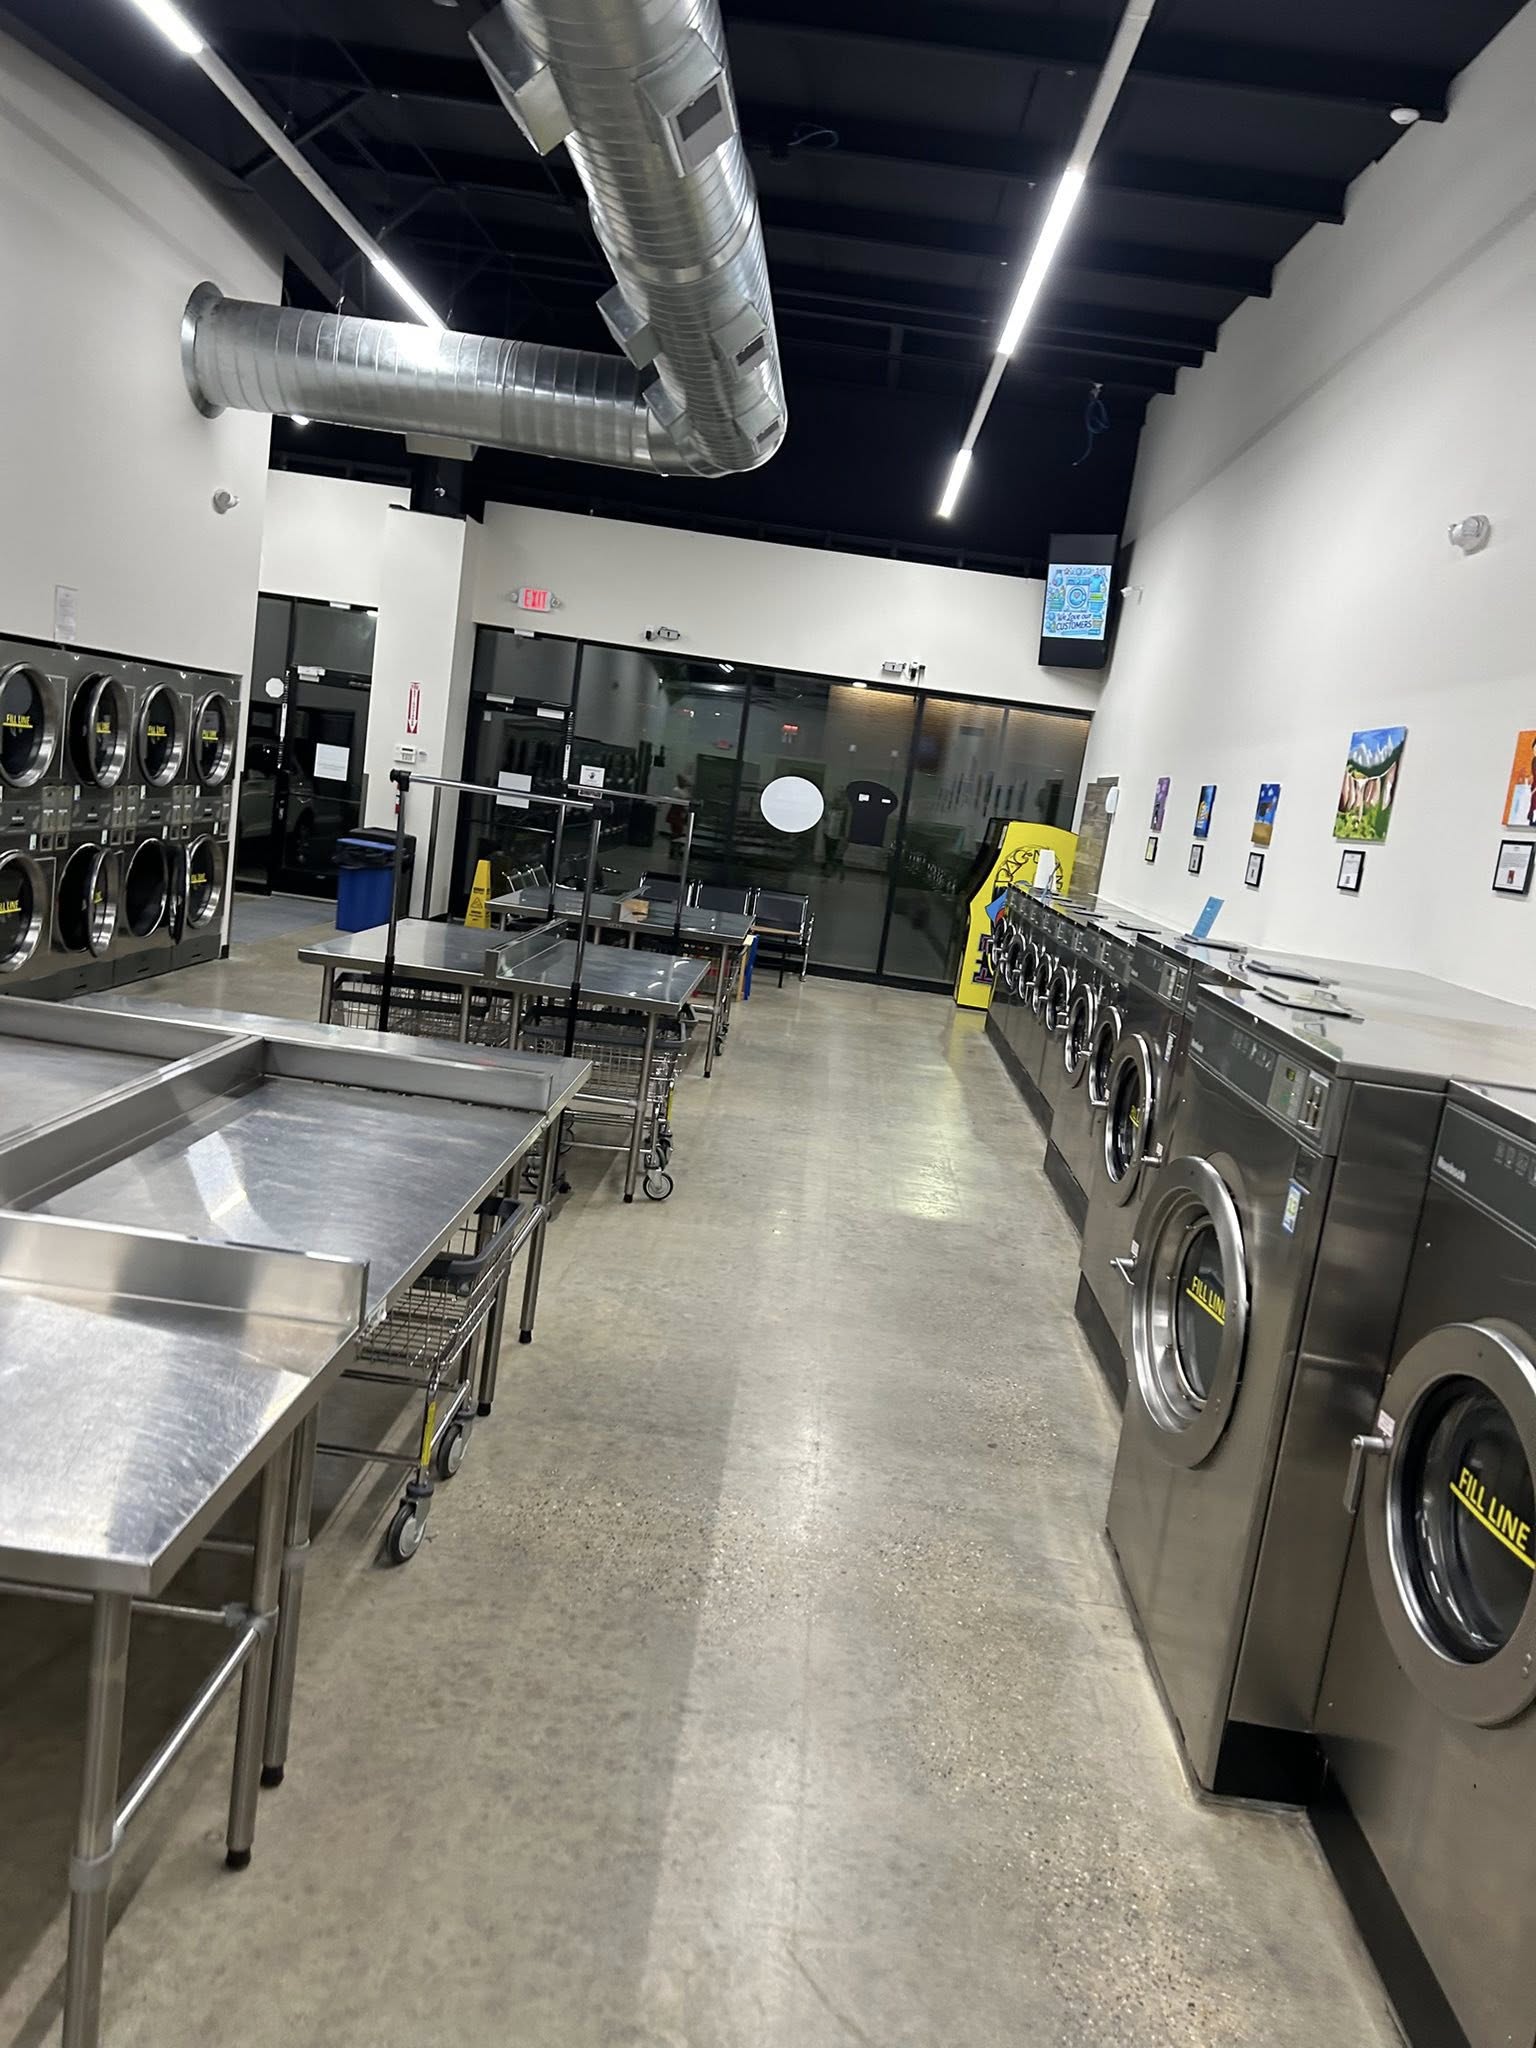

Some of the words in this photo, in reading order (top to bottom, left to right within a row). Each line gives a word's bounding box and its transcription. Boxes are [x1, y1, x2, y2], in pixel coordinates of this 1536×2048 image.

[524, 589, 548, 609] EXIT
[1056, 620, 1092, 631] CUSTOMERS
[1191, 1275, 1207, 1302] FILL
[1208, 1289, 1225, 1320] LIN
[1459, 1467, 1485, 1513] FILL
[1488, 1497, 1531, 1551] LINE
